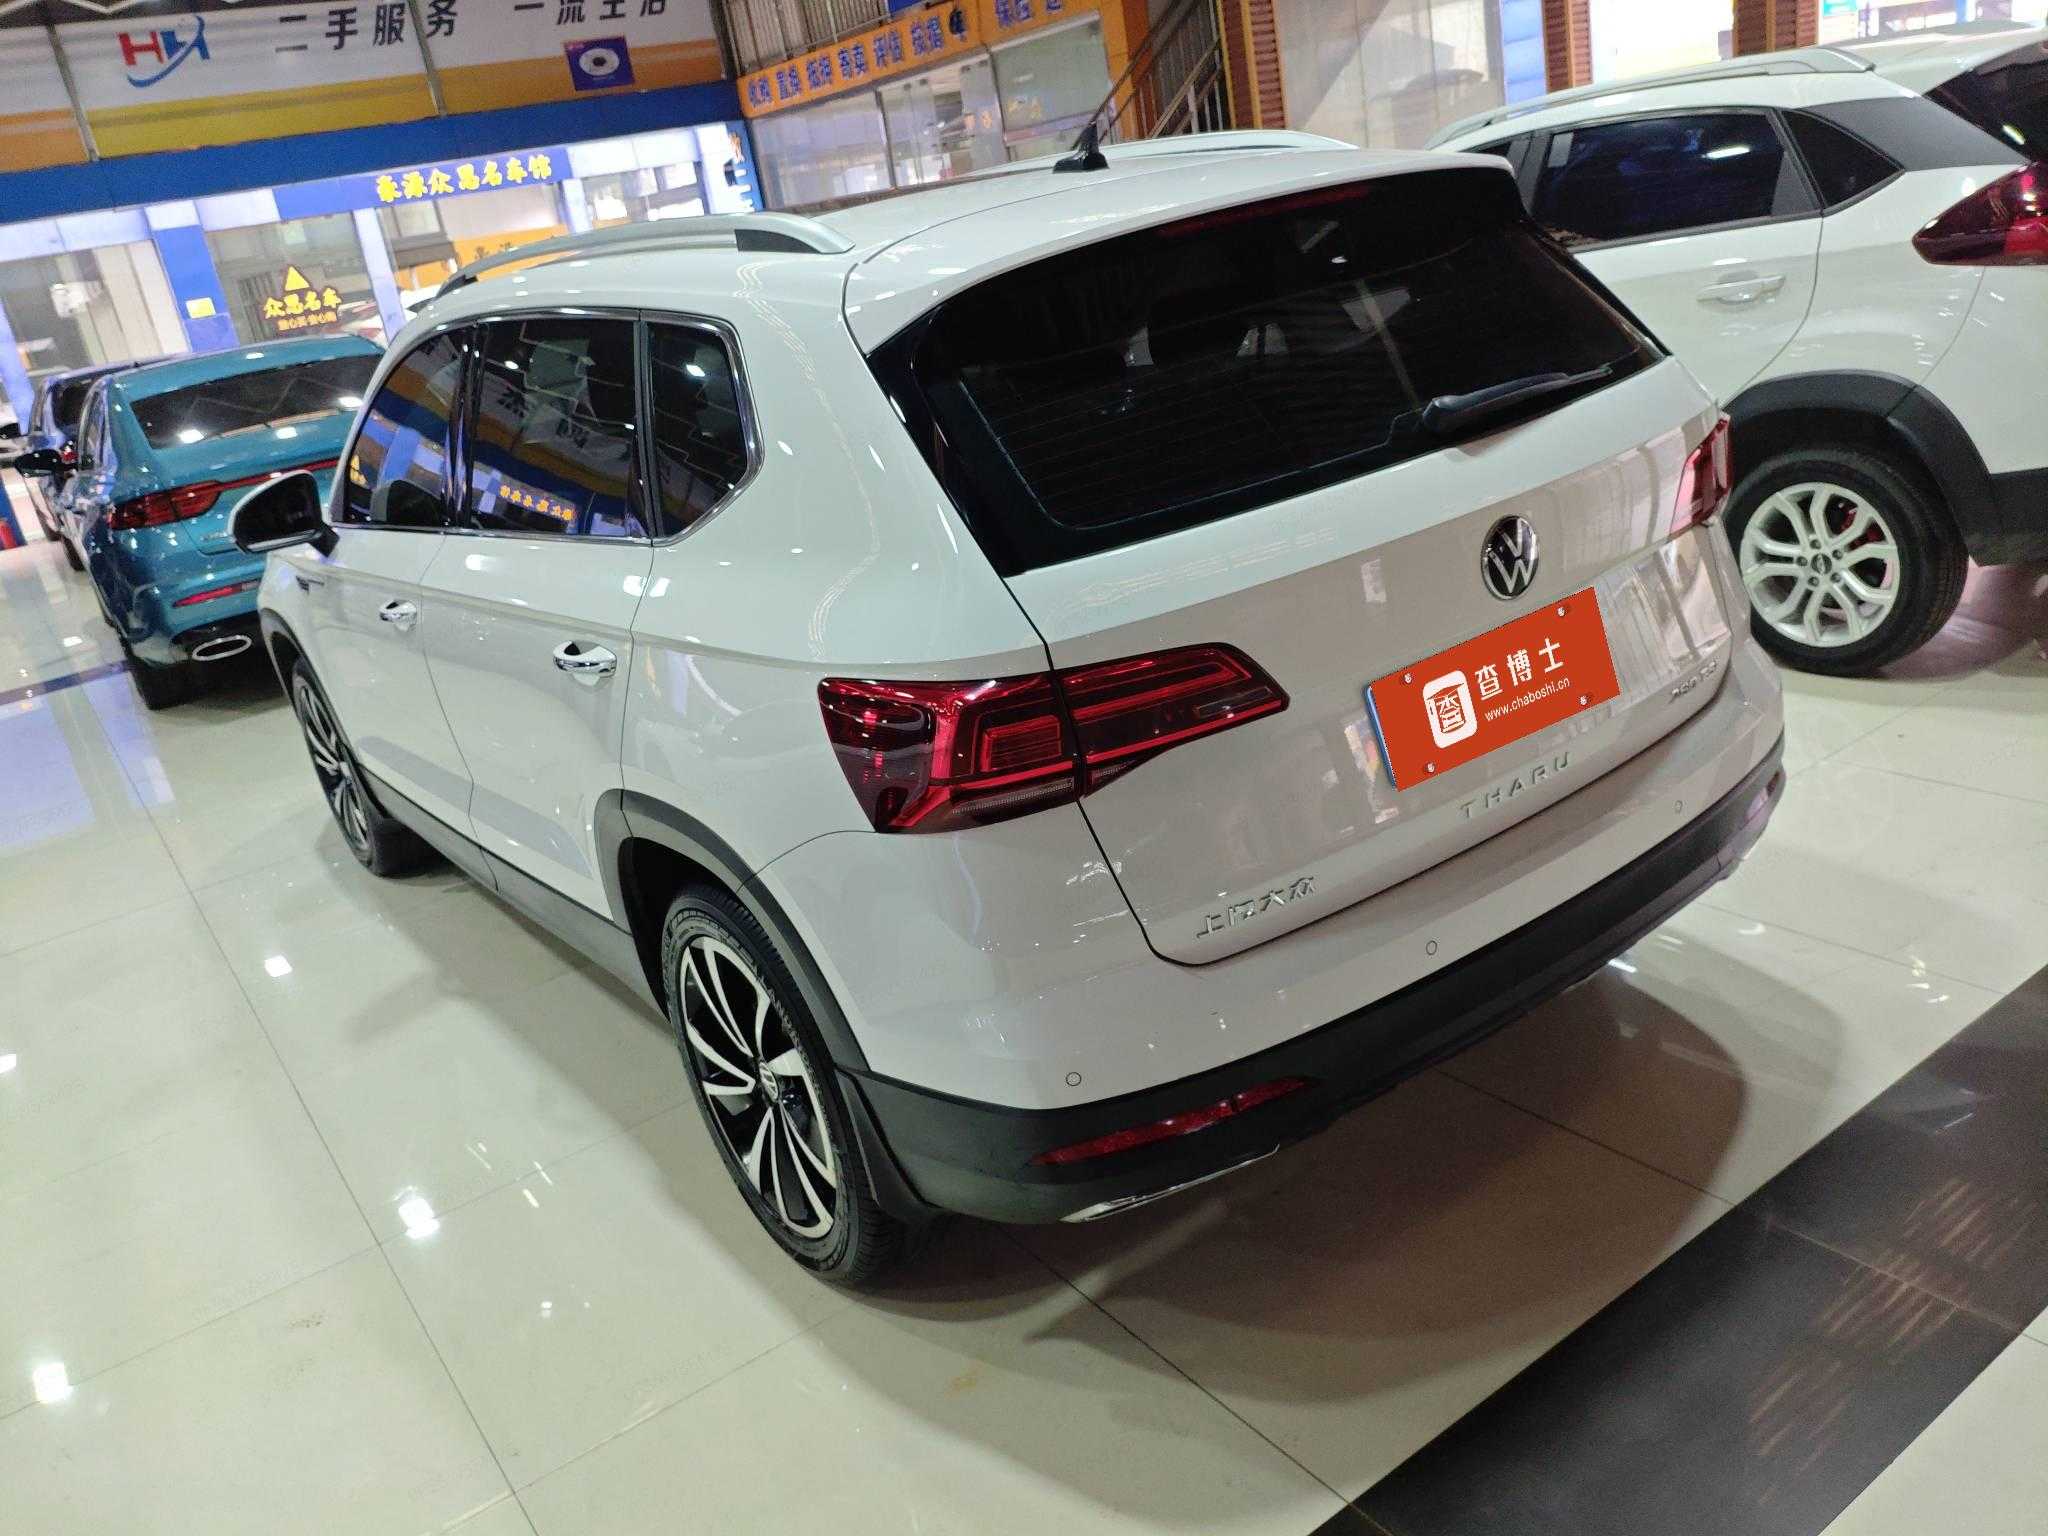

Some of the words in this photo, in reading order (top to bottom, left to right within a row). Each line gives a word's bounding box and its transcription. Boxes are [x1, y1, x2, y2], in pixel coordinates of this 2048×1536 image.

[275, 0, 458, 54] 二手服务
[1459, 751, 1570, 819] THARU
[1196, 875, 1317, 938] 上汽大众
